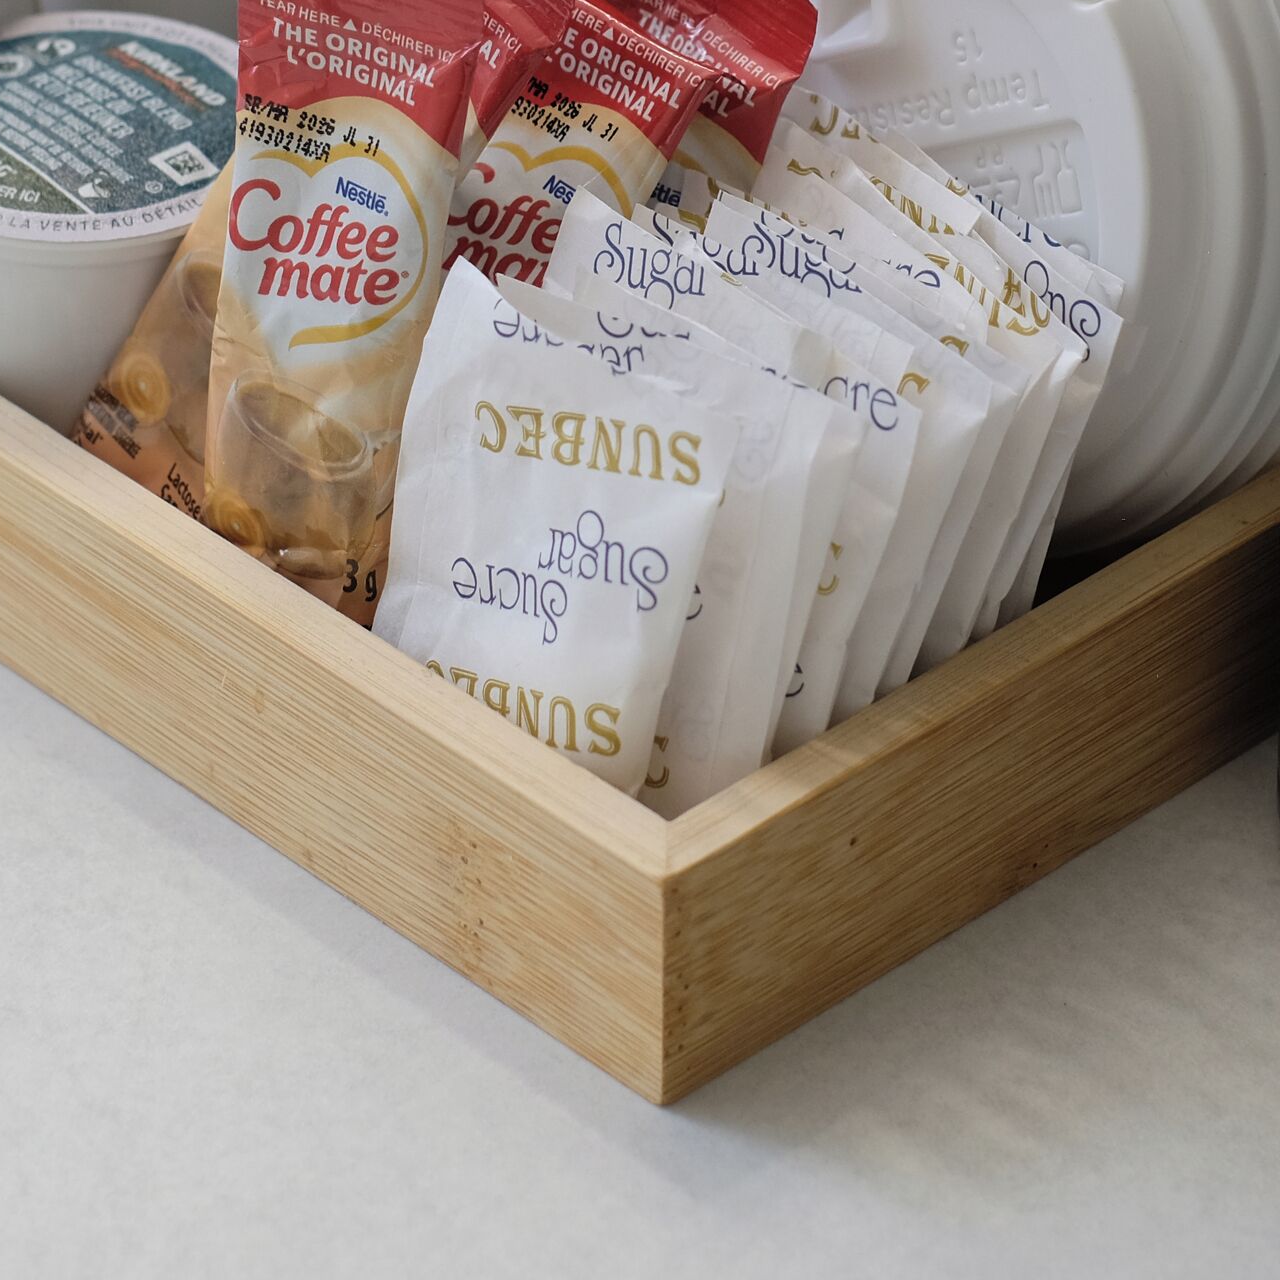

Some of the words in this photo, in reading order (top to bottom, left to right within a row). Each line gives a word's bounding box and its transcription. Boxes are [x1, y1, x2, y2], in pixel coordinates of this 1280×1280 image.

[299, 8, 341, 28] HERE
[361, 21, 434, 57] DÉCHIRER
[438, 49, 456, 63] ICI
[503, 33, 523, 54] ICI
[637, 8, 671, 44] THE
[273, 17, 319, 47] THE
[325, 33, 436, 88] ORIGINAL
[286, 45, 416, 107] L'ORIGINAL
[581, 39, 682, 110] ORIGINAL
[617, 32, 687, 81] DÉCHIRER
[545, 47, 653, 122] 'ORIGINAL
[763, 73, 782, 90] ICI
[967, 70, 1050, 112] Temp
[297, 111, 336, 136] 2026
[343, 126, 357, 147] JL
[364, 136, 381, 157] 31
[511, 95, 571, 143] 930214XA
[550, 92, 583, 120] 2026
[583, 114, 597, 133] JL
[600, 122, 620, 142] 31
[19, 188, 41, 204] ICI
[542, 174, 577, 205] Nes
[9, 216, 31, 229] LA
[40, 219, 102, 232] VENTE
[110, 215, 135, 229] AU
[228, 178, 399, 262] Coffee
[257, 256, 401, 306] mate
[474, 400, 703, 487] SUNBEC
[167, 462, 203, 521] Lactose
[342, 558, 359, 594] 3
[365, 569, 378, 602] g
[537, 510, 669, 612] Sugar
[450, 556, 568, 646] Sucre
